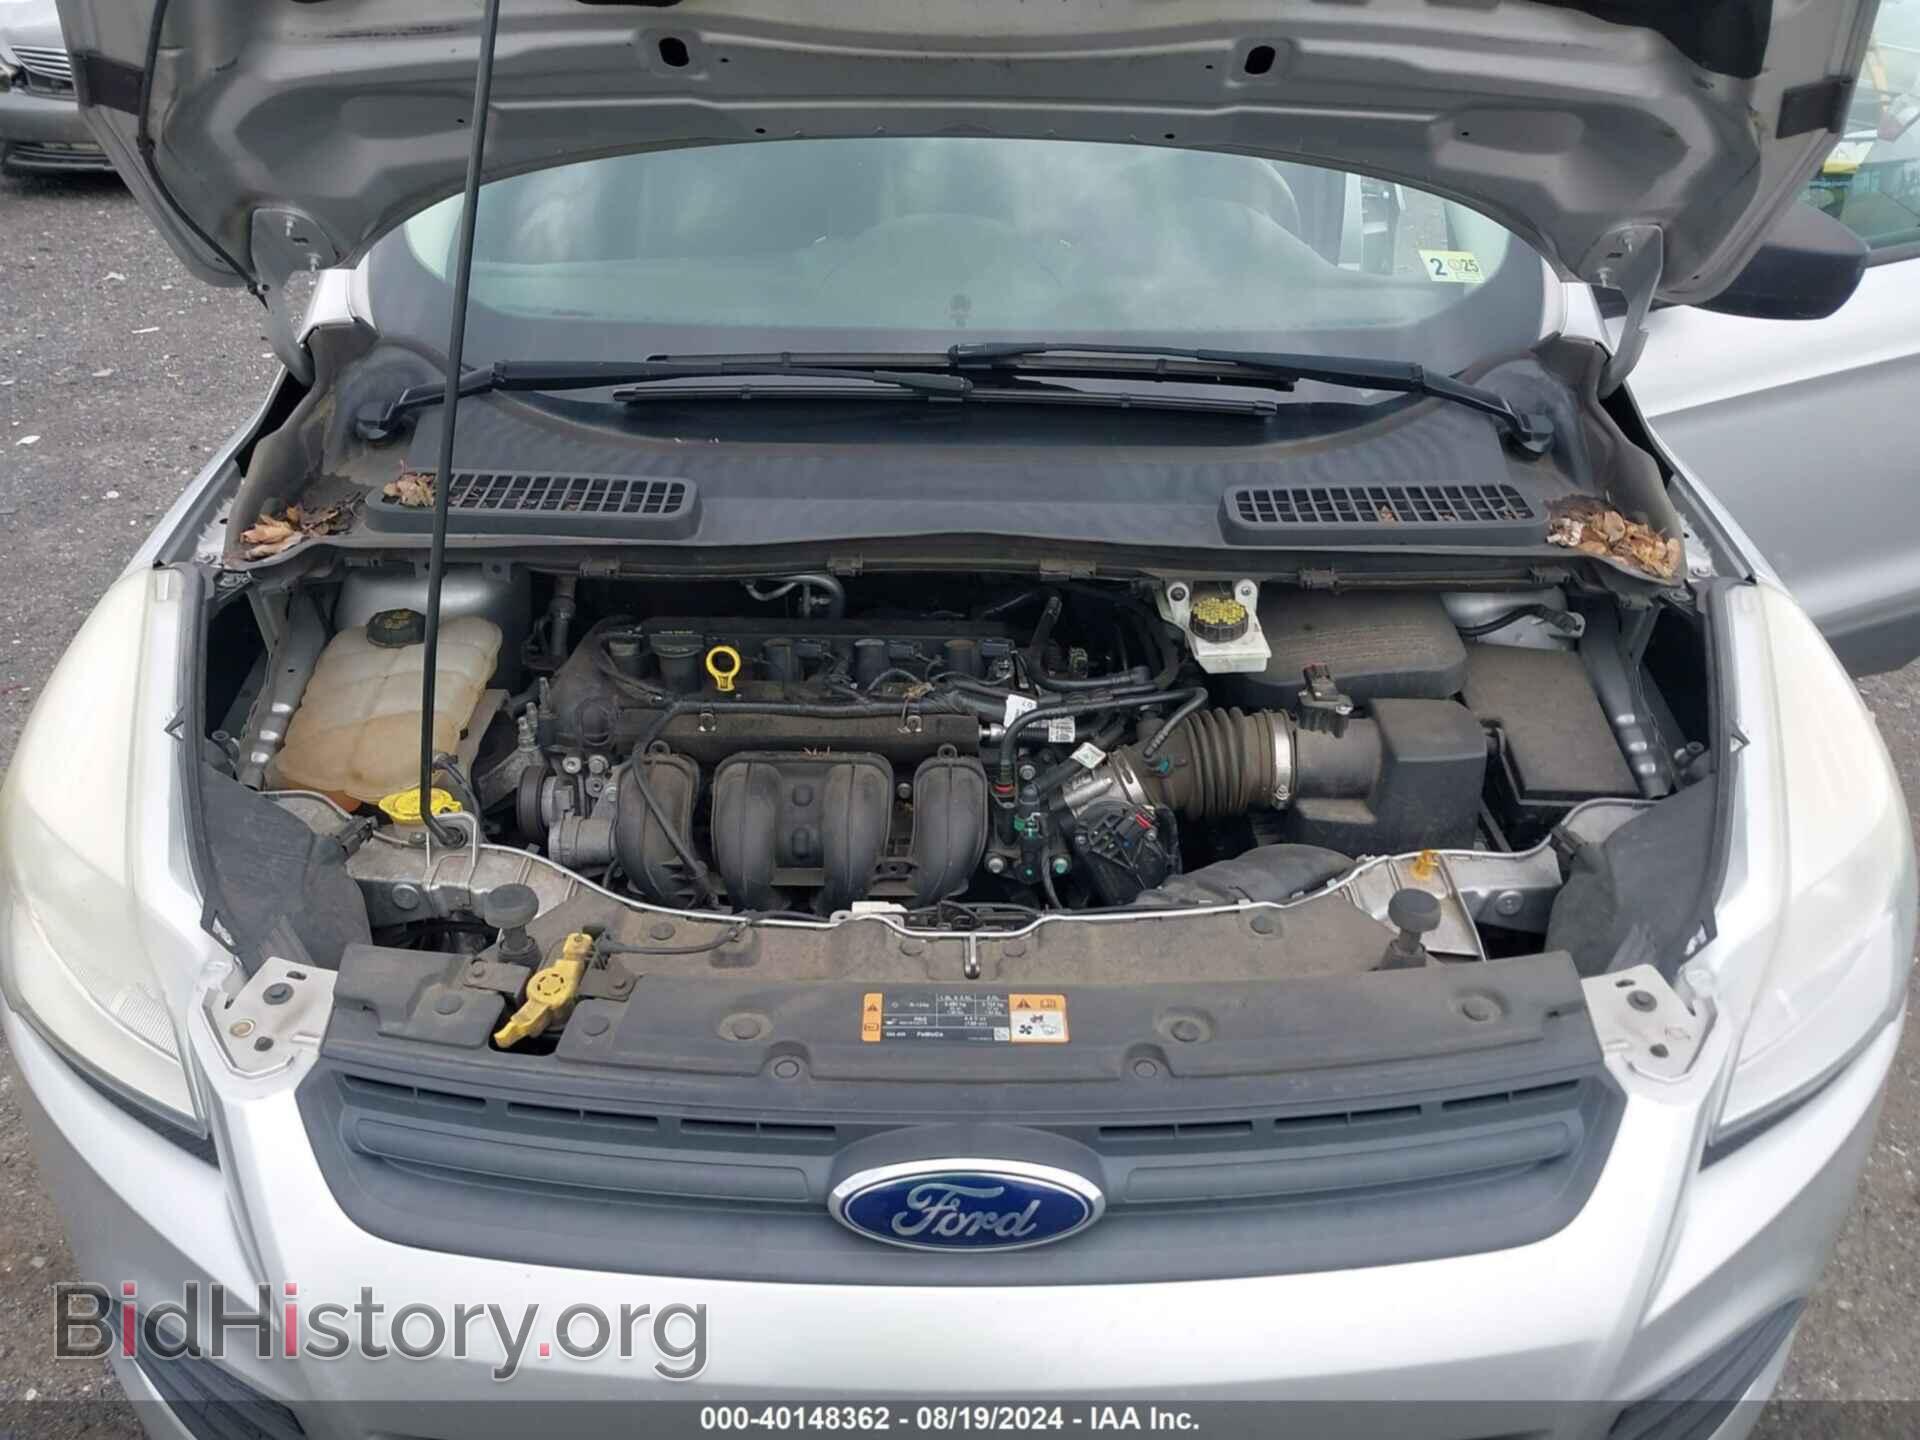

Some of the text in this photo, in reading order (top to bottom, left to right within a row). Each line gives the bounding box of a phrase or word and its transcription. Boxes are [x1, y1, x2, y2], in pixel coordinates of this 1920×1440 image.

[1430, 258, 1479, 276] 2 25
[891, 1182, 1041, 1237] Ford
